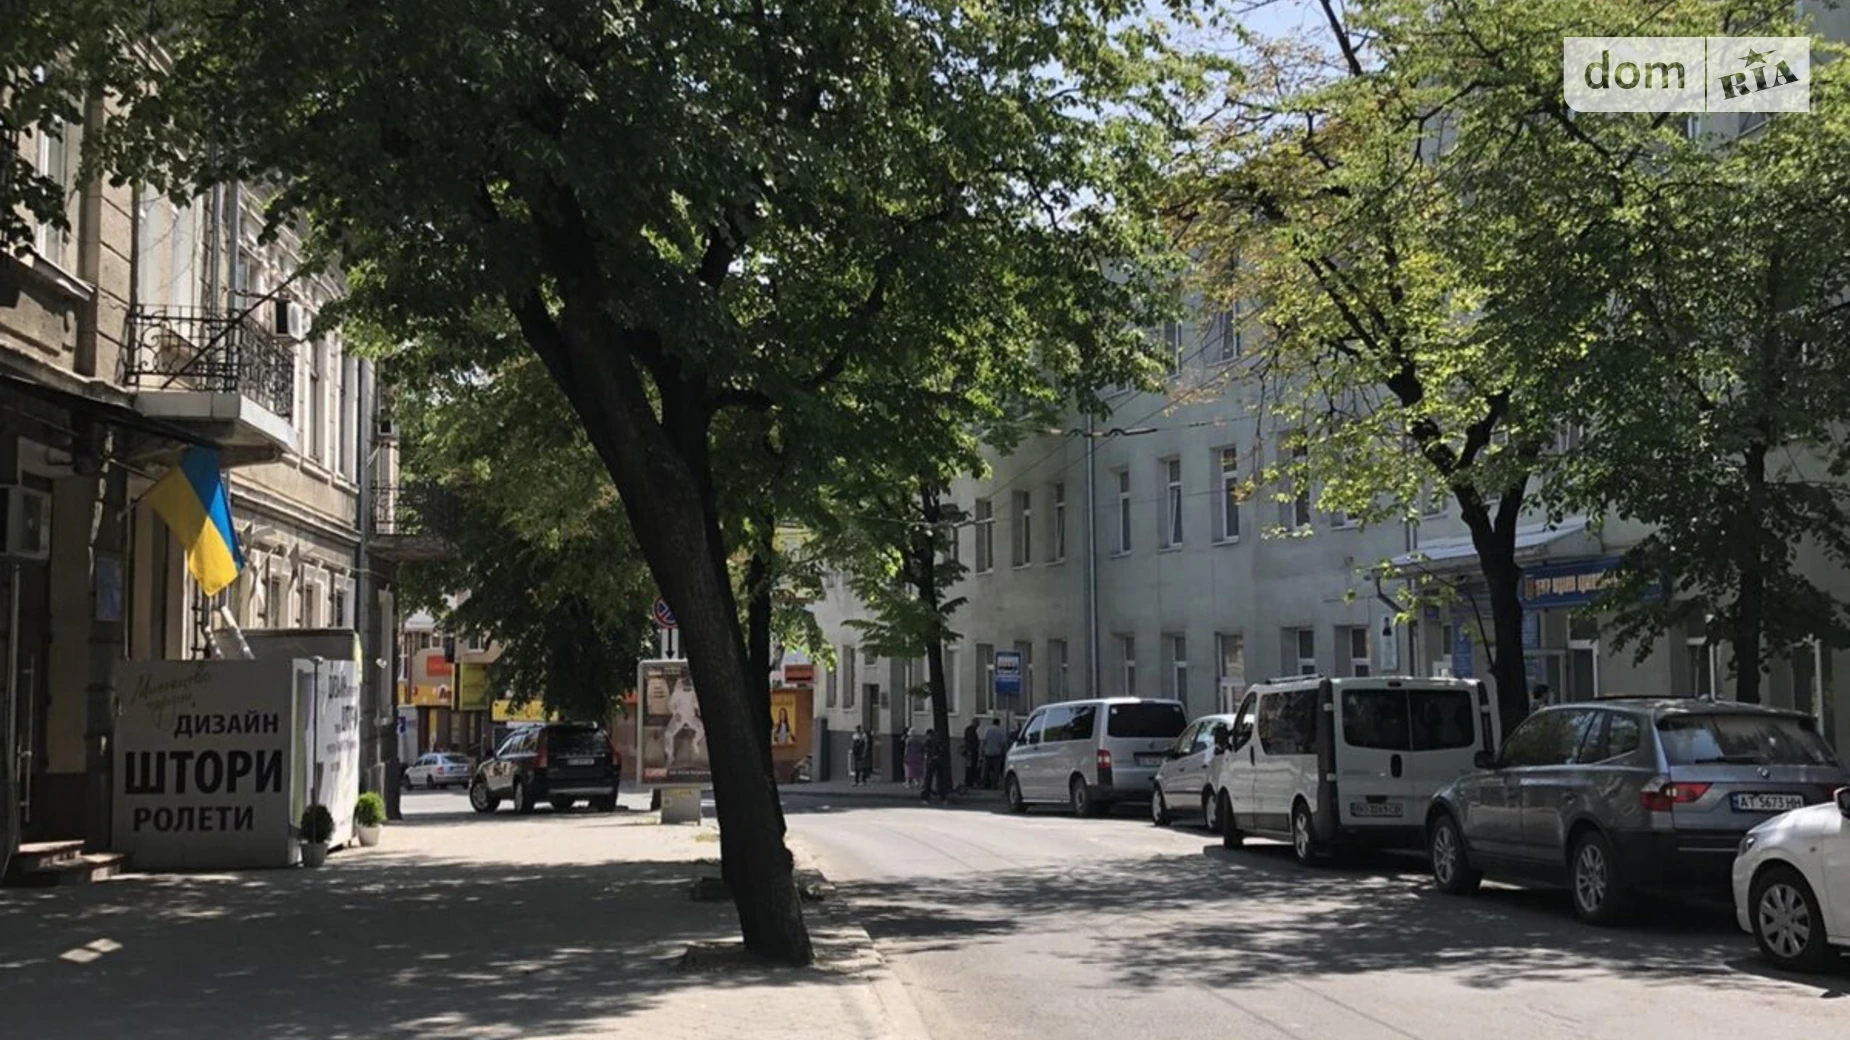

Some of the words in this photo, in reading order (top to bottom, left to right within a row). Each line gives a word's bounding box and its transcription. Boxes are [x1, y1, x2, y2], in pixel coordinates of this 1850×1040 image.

[174, 710, 279, 738] ДИЗАЙН
[125, 749, 282, 794] ШТОРИ
[134, 806, 254, 832] РОЛЕТИ
